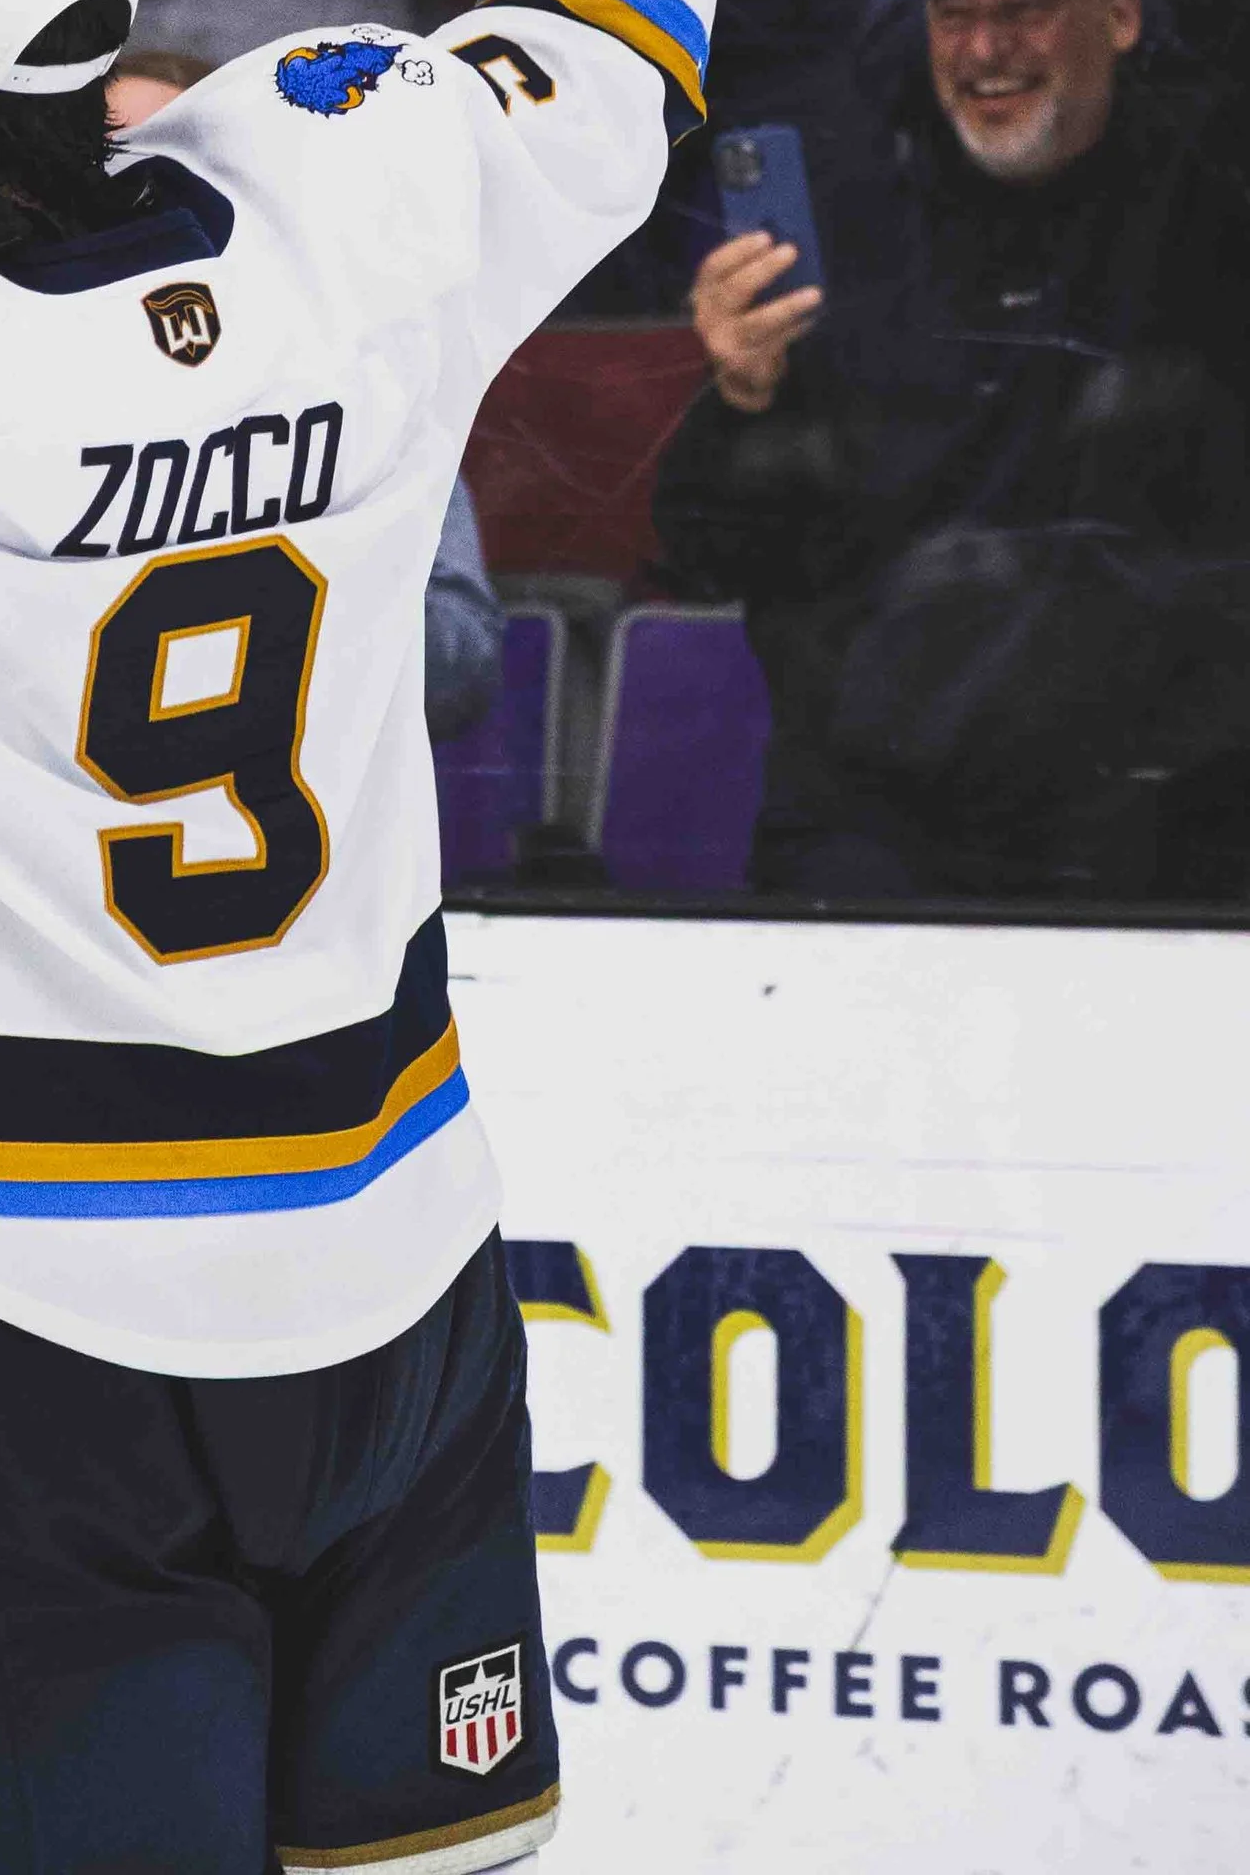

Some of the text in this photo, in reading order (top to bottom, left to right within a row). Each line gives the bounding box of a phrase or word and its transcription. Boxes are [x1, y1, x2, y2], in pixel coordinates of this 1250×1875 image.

[51, 401, 344, 558] ZOCCO
[75, 534, 330, 966] 9
[445, 1684, 516, 1725] USHL
[551, 1636, 1250, 1738] COFFEE ROA
